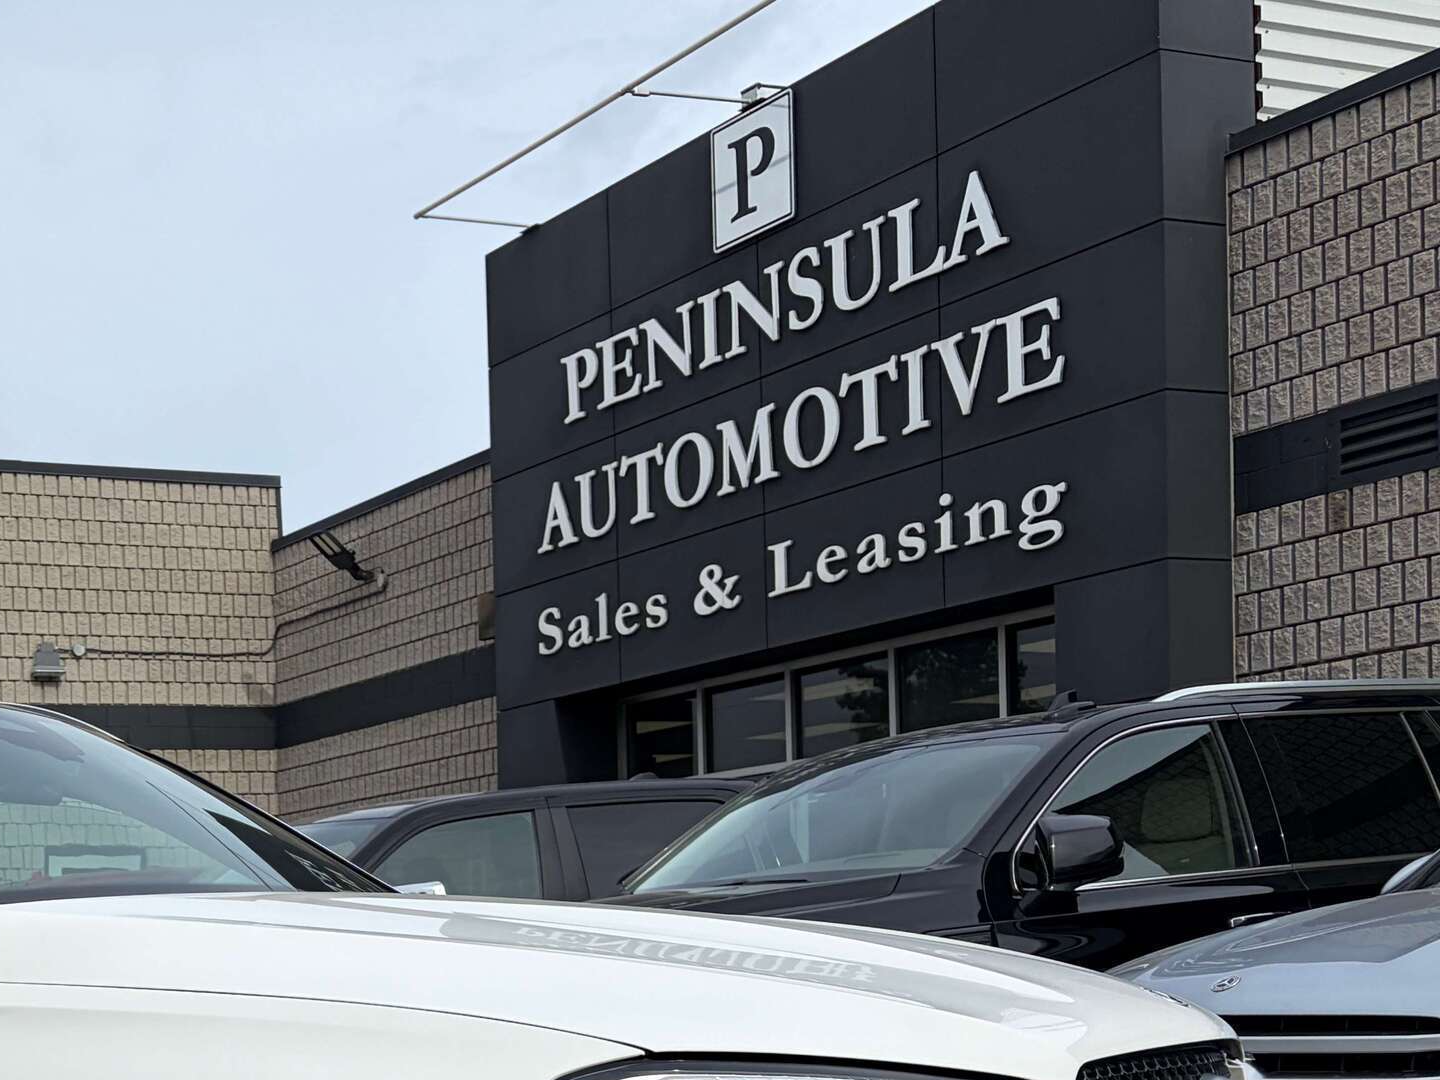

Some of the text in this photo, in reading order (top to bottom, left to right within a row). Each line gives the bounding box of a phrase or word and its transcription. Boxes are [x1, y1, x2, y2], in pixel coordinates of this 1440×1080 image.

[727, 125, 777, 225] P
[561, 170, 1010, 424] PENINSULA
[537, 297, 1066, 554] AUTOMOTIVE
[538, 480, 1068, 656] Sales & Leasing
